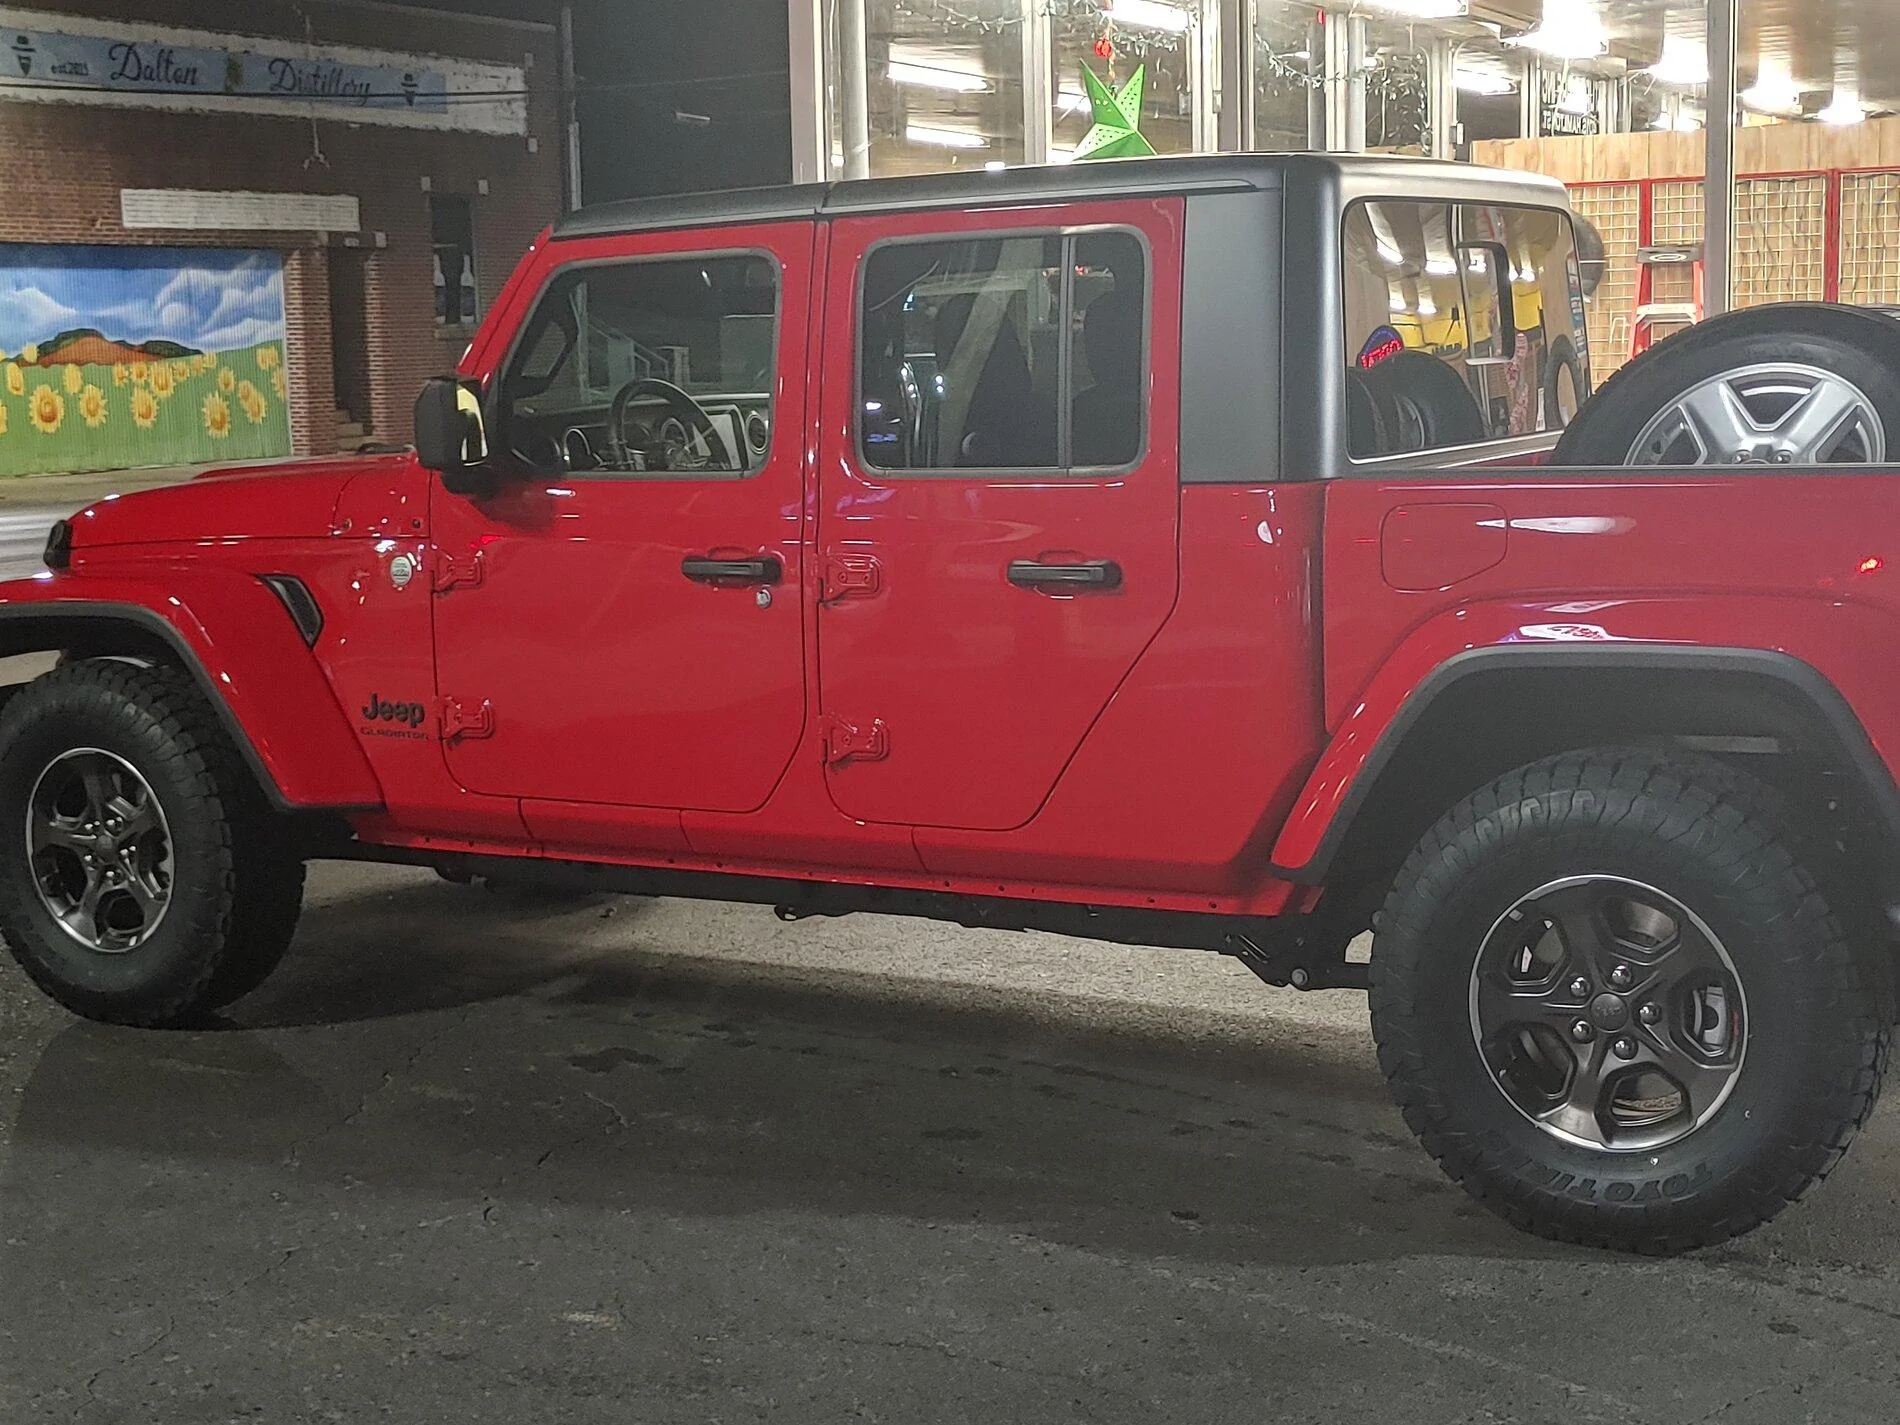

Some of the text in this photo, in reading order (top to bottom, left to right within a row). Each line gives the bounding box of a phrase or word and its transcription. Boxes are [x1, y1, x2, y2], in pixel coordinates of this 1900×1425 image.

[109, 42, 198, 85] Dalton
[362, 692, 425, 728] Jeep
[1603, 1162, 1713, 1201] TOYO
